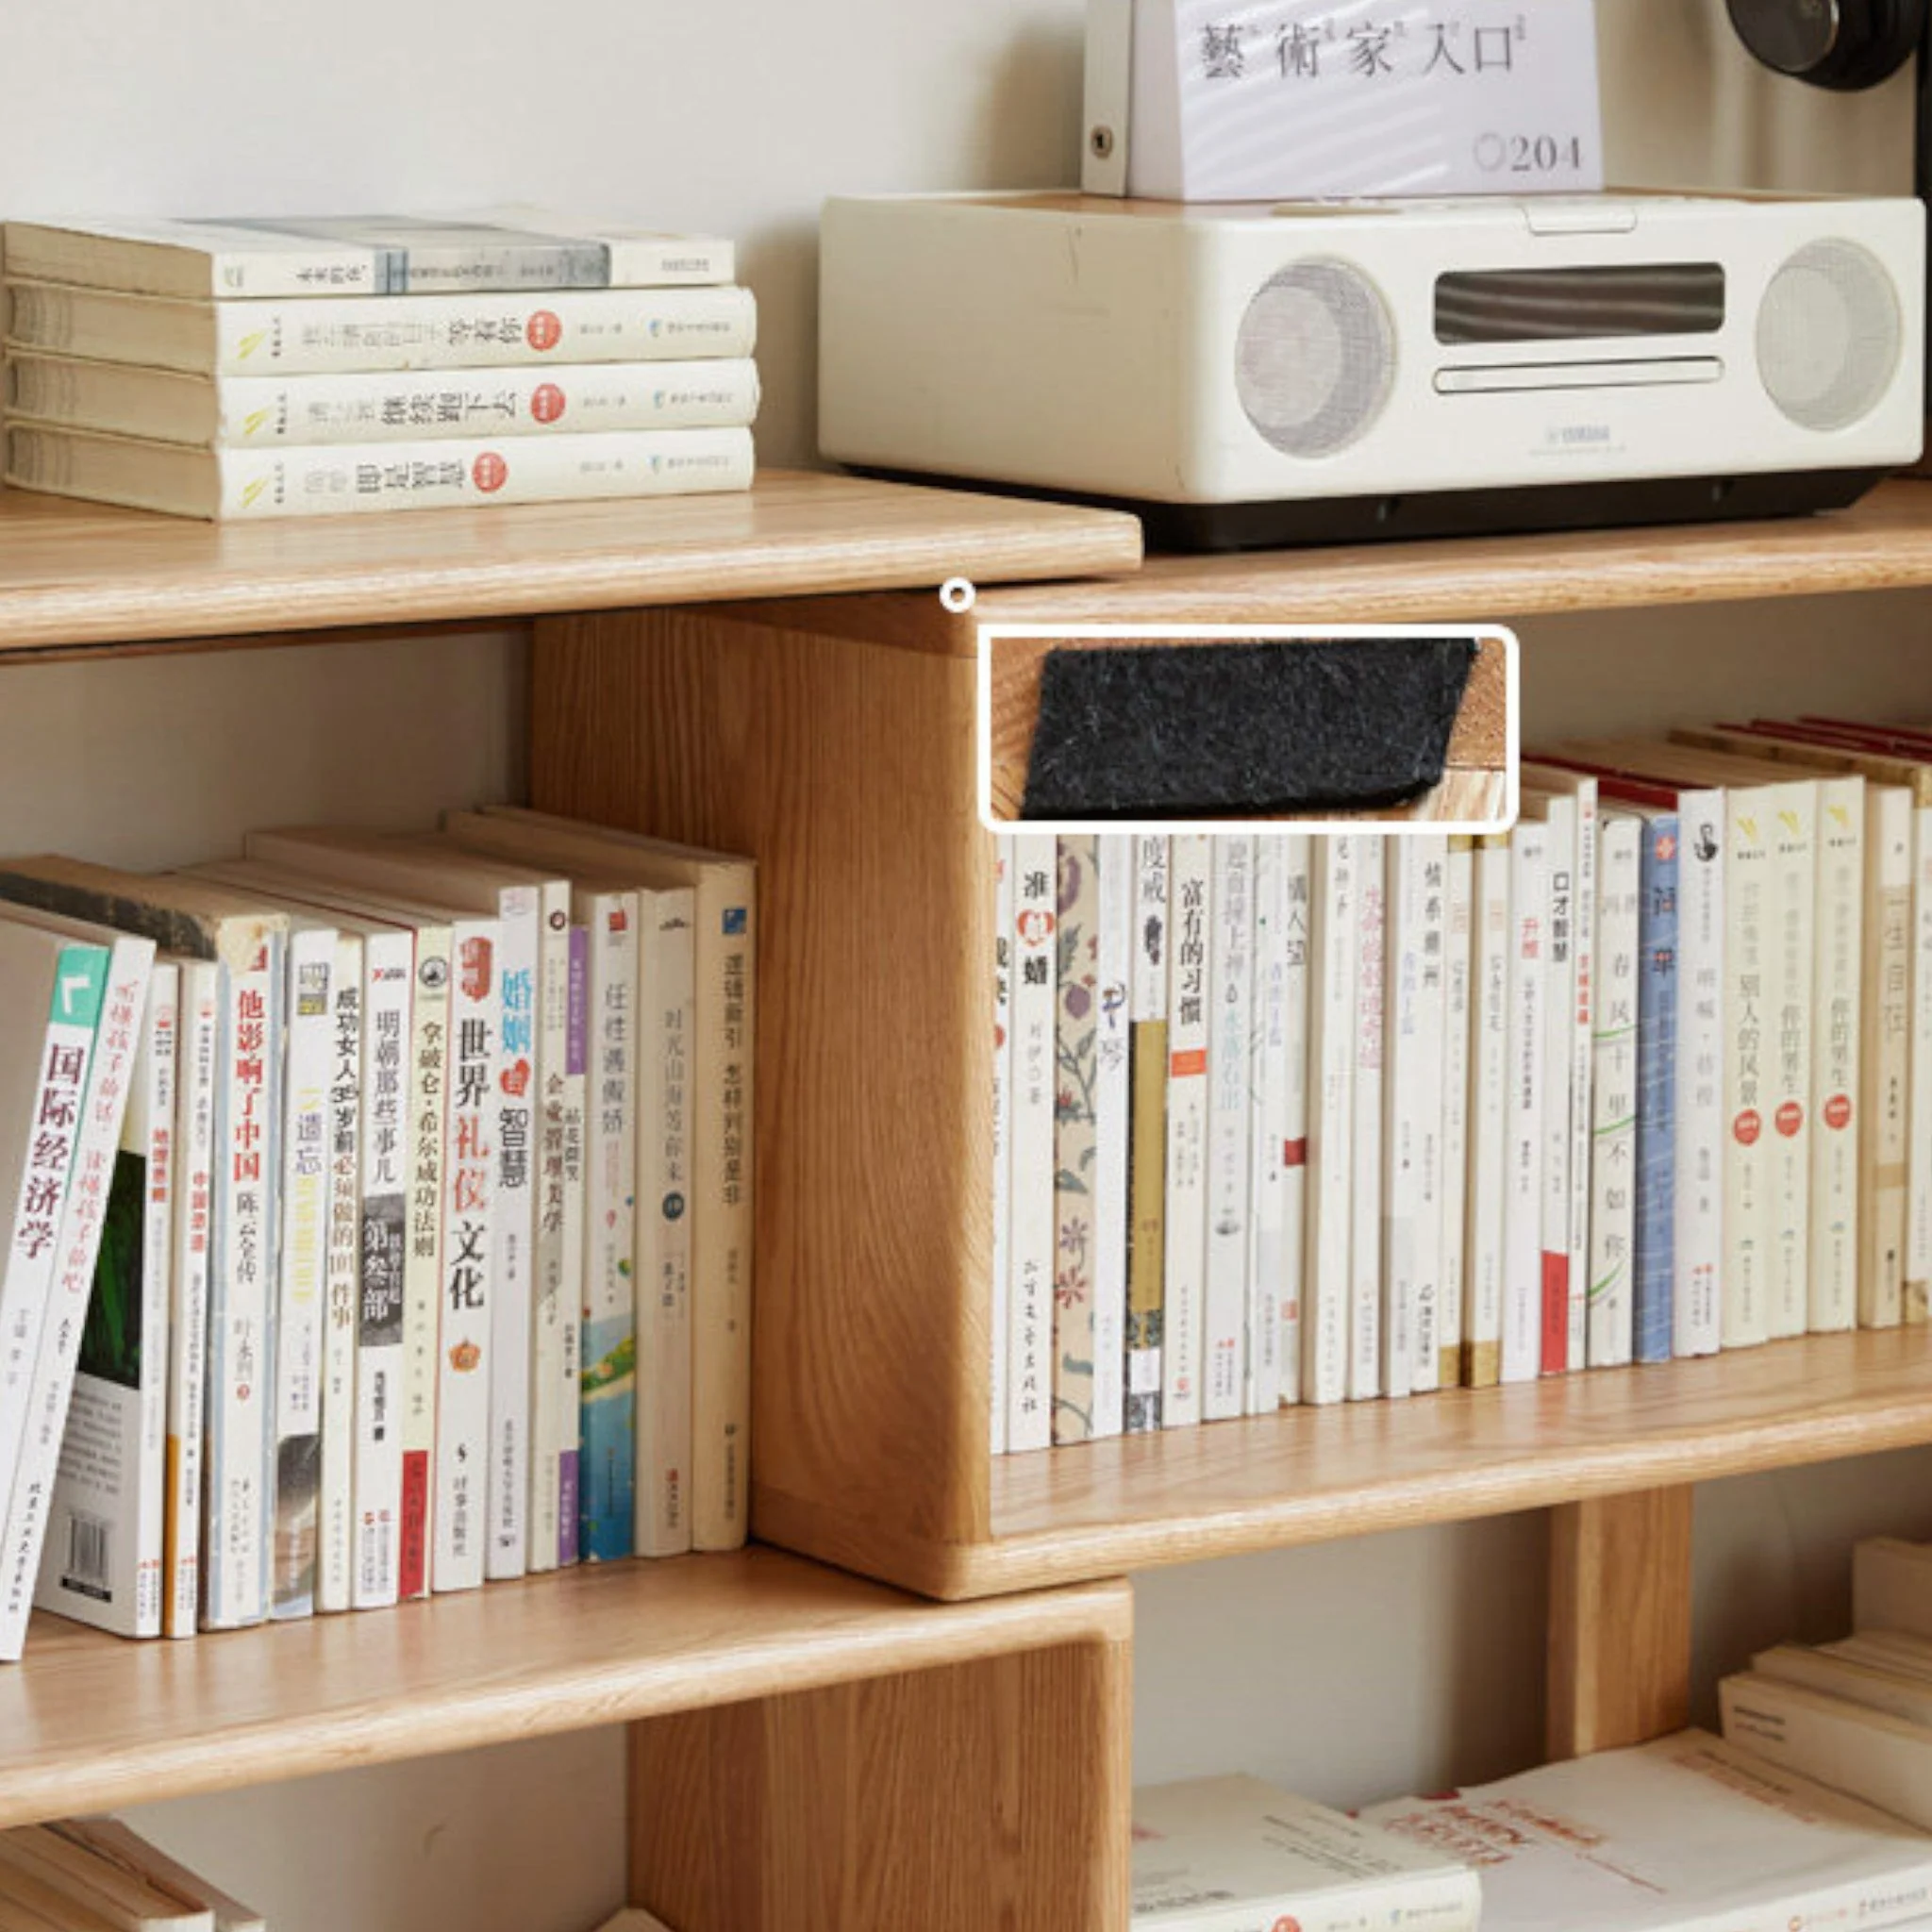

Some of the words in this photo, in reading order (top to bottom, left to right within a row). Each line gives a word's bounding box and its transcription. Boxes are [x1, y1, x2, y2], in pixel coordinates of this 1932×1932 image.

[18, 1043, 86, 1260] 国际经济学
[232, 990, 266, 1182] 他影响了中国
[374, 1009, 401, 1185] 明朝那些事儿
[450, 1018, 493, 1310] 世界礼仪文化
